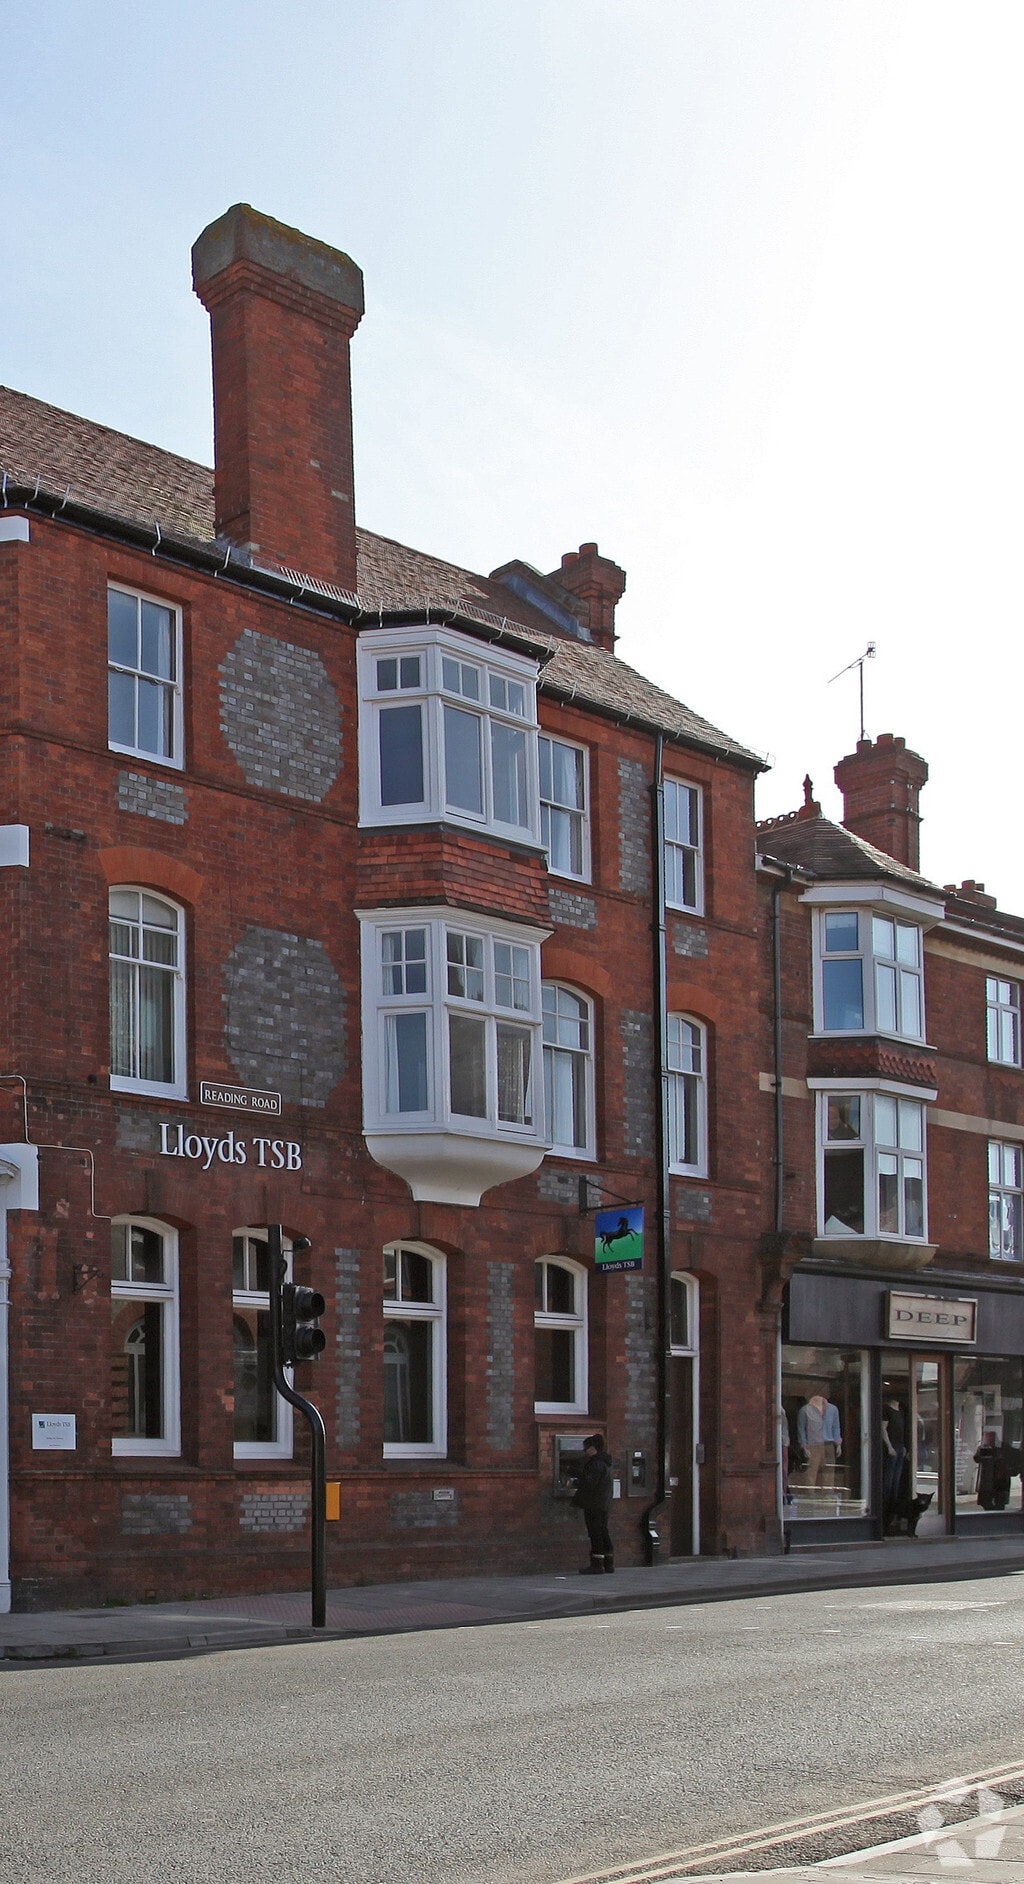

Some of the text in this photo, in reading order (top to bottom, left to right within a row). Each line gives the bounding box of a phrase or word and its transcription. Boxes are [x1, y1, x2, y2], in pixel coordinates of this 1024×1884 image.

[204, 1089, 278, 1110] READING ROAD
[158, 1122, 303, 1171] Lloyds TSB
[601, 1260, 636, 1271] Lloyds TSB
[895, 1309, 968, 1327] DEEP
